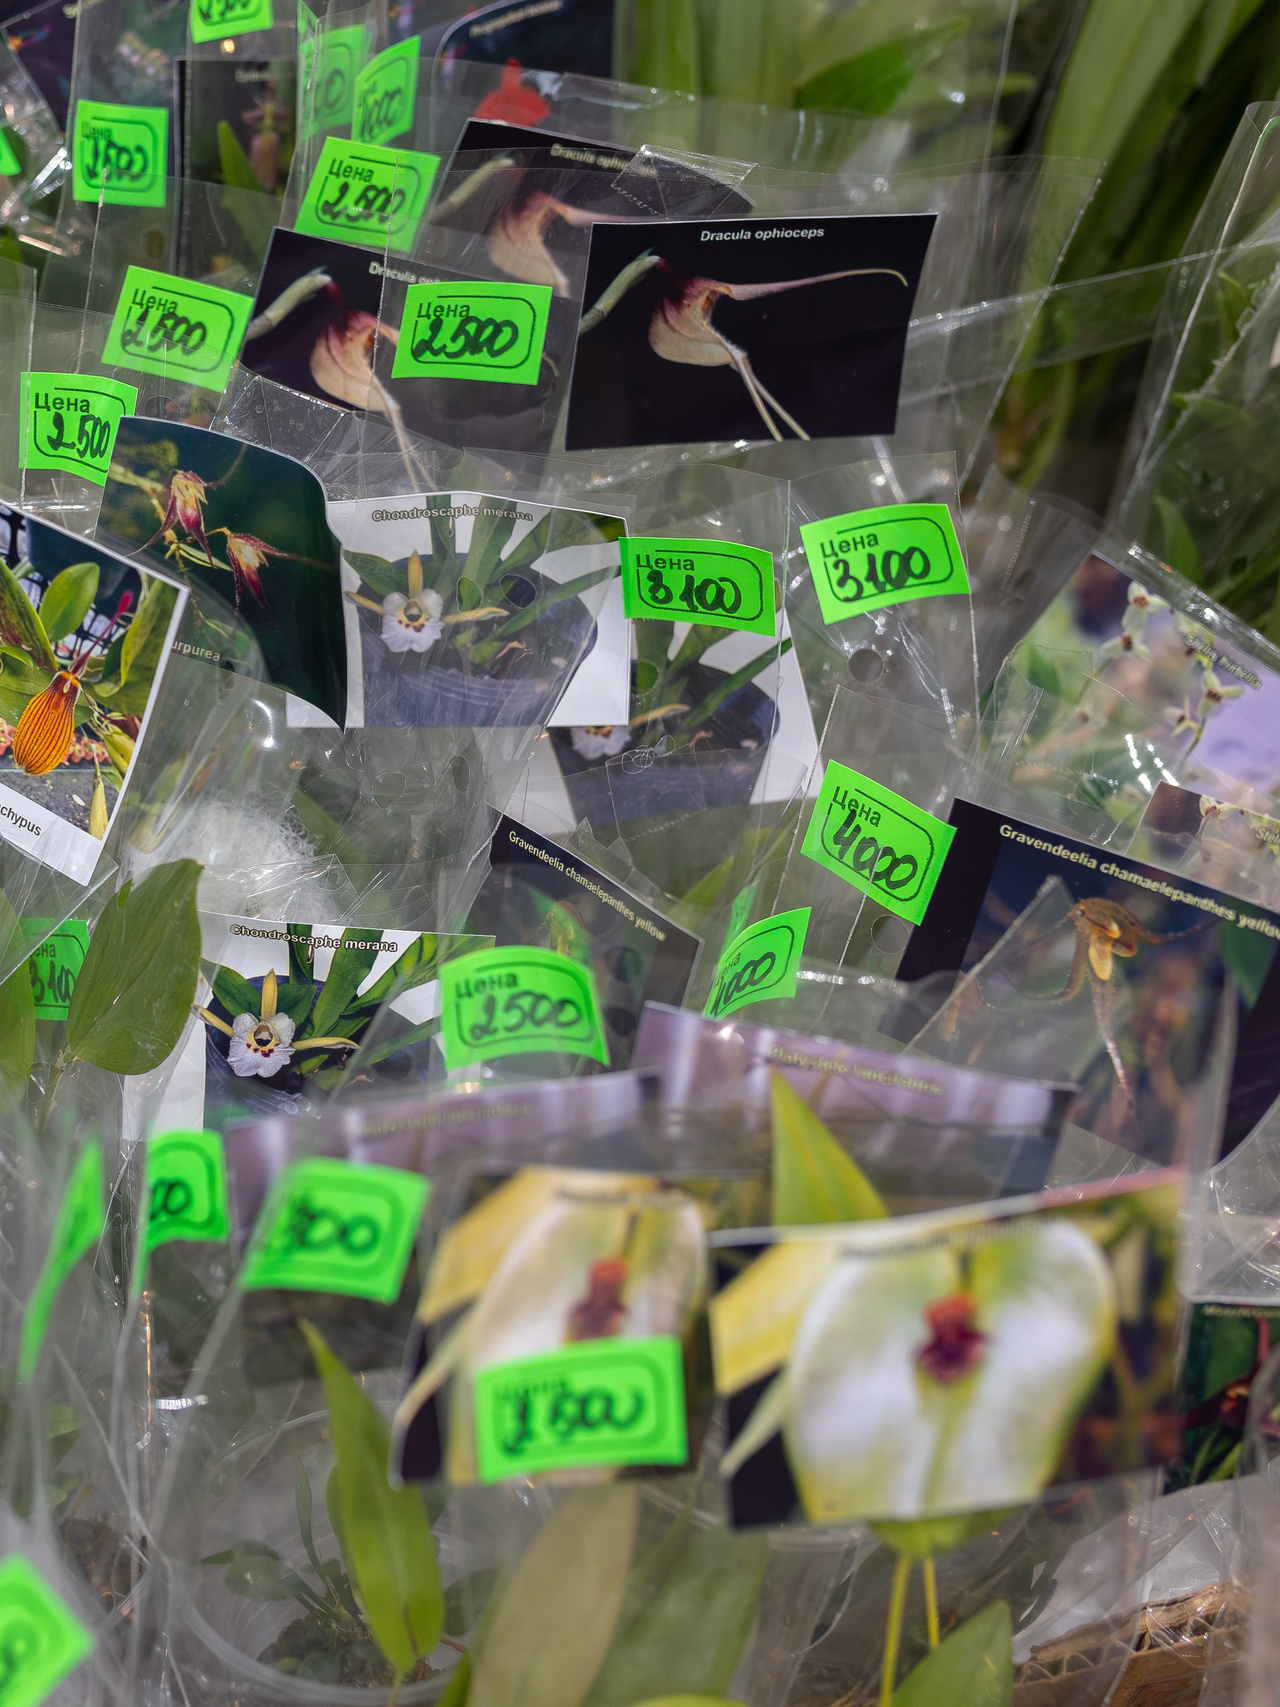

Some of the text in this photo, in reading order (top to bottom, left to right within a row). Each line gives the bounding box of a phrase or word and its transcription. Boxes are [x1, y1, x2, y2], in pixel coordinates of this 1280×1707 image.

[329, 158, 375, 182] Цена
[700, 227, 825, 241] Dracula ophioceps
[368, 261, 417, 284] Dracula
[131, 288, 178, 313] Цена
[417, 302, 471, 320] Цена
[411, 315, 519, 360] 2500
[35, 392, 90, 413] Цена
[46, 411, 111, 459] 2500
[371, 504, 534, 522] Chondroscaphe merana
[820, 533, 879, 558] Цена
[636, 553, 695, 571] Цена
[833, 546, 931, 602] 3100
[171, 640, 220, 661] urpurea
[832, 785, 882, 828] Цена
[832, 808, 918, 890] 4000
[999, 824, 1098, 870] Gravendeelia
[1099, 861, 1237, 922] chamaelepanthes
[508, 830, 668, 942] Gravendeelia chamaelepanthes yellow
[230, 924, 398, 952] Chondroscaphe merana
[456, 973, 517, 999] Цена
[470, 991, 582, 1041] 2500
